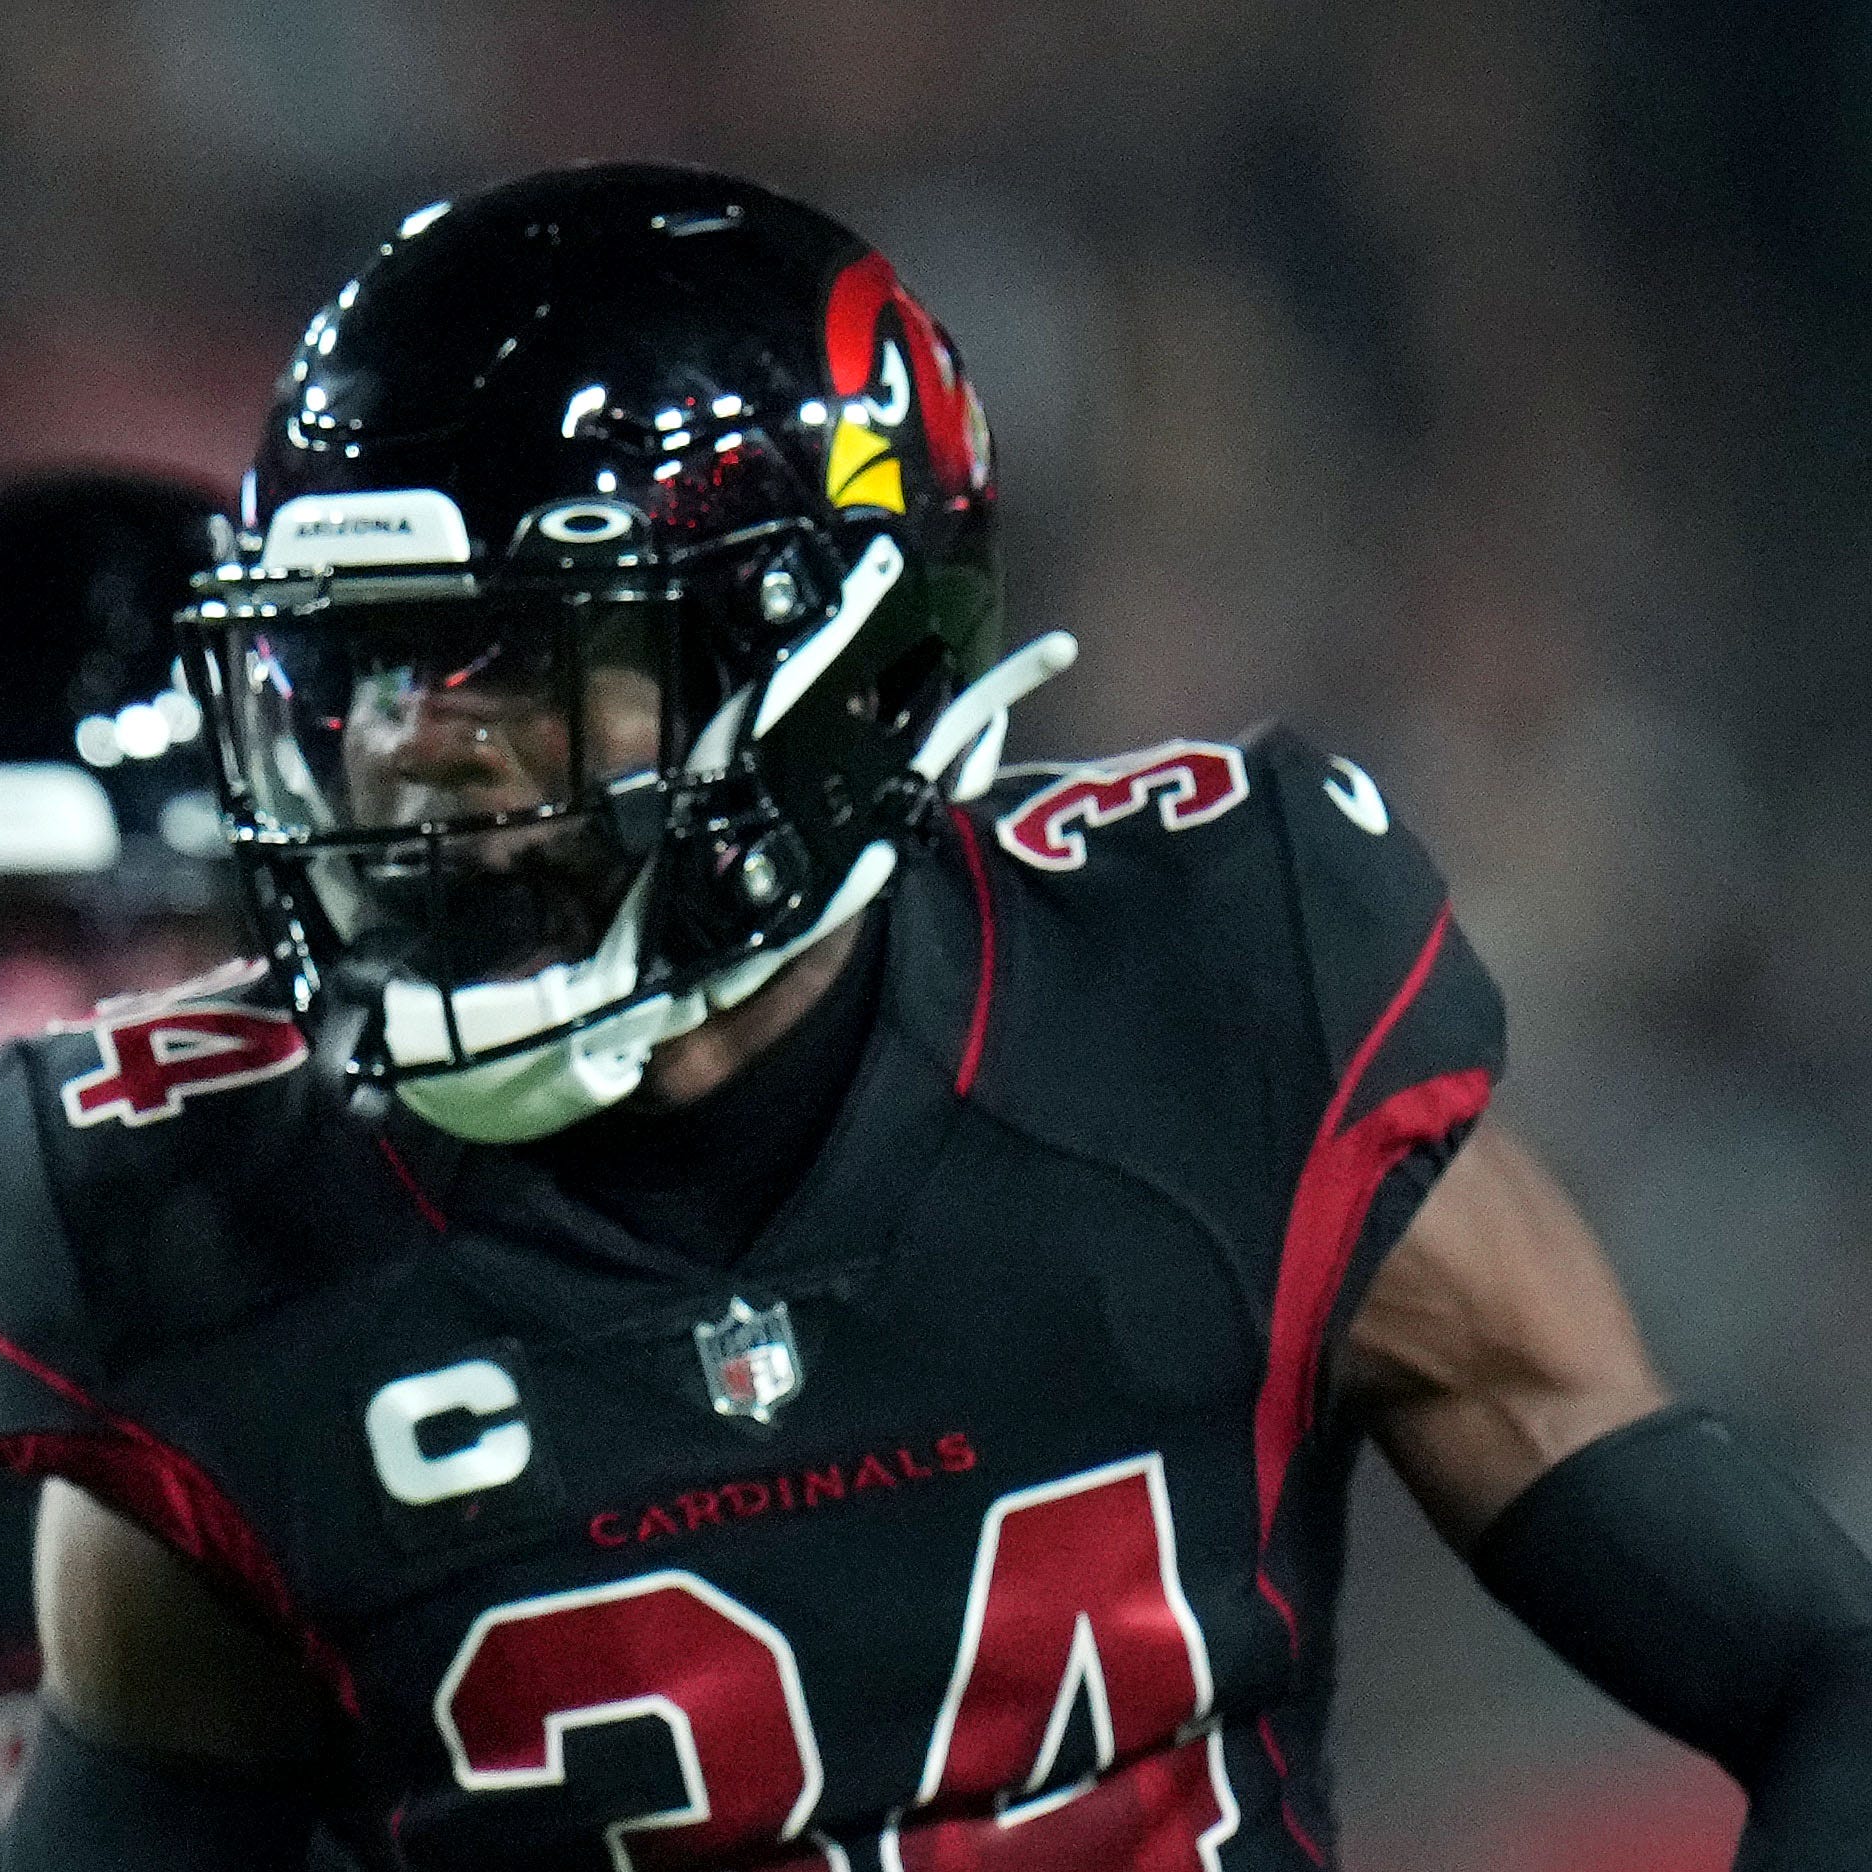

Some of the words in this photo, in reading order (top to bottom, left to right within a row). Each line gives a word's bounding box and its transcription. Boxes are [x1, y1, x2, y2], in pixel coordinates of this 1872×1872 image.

[996, 739, 1250, 871] 3
[47, 956, 309, 1128] 4
[365, 1358, 532, 1506] C
[588, 1432, 977, 1547] CARDINALS
